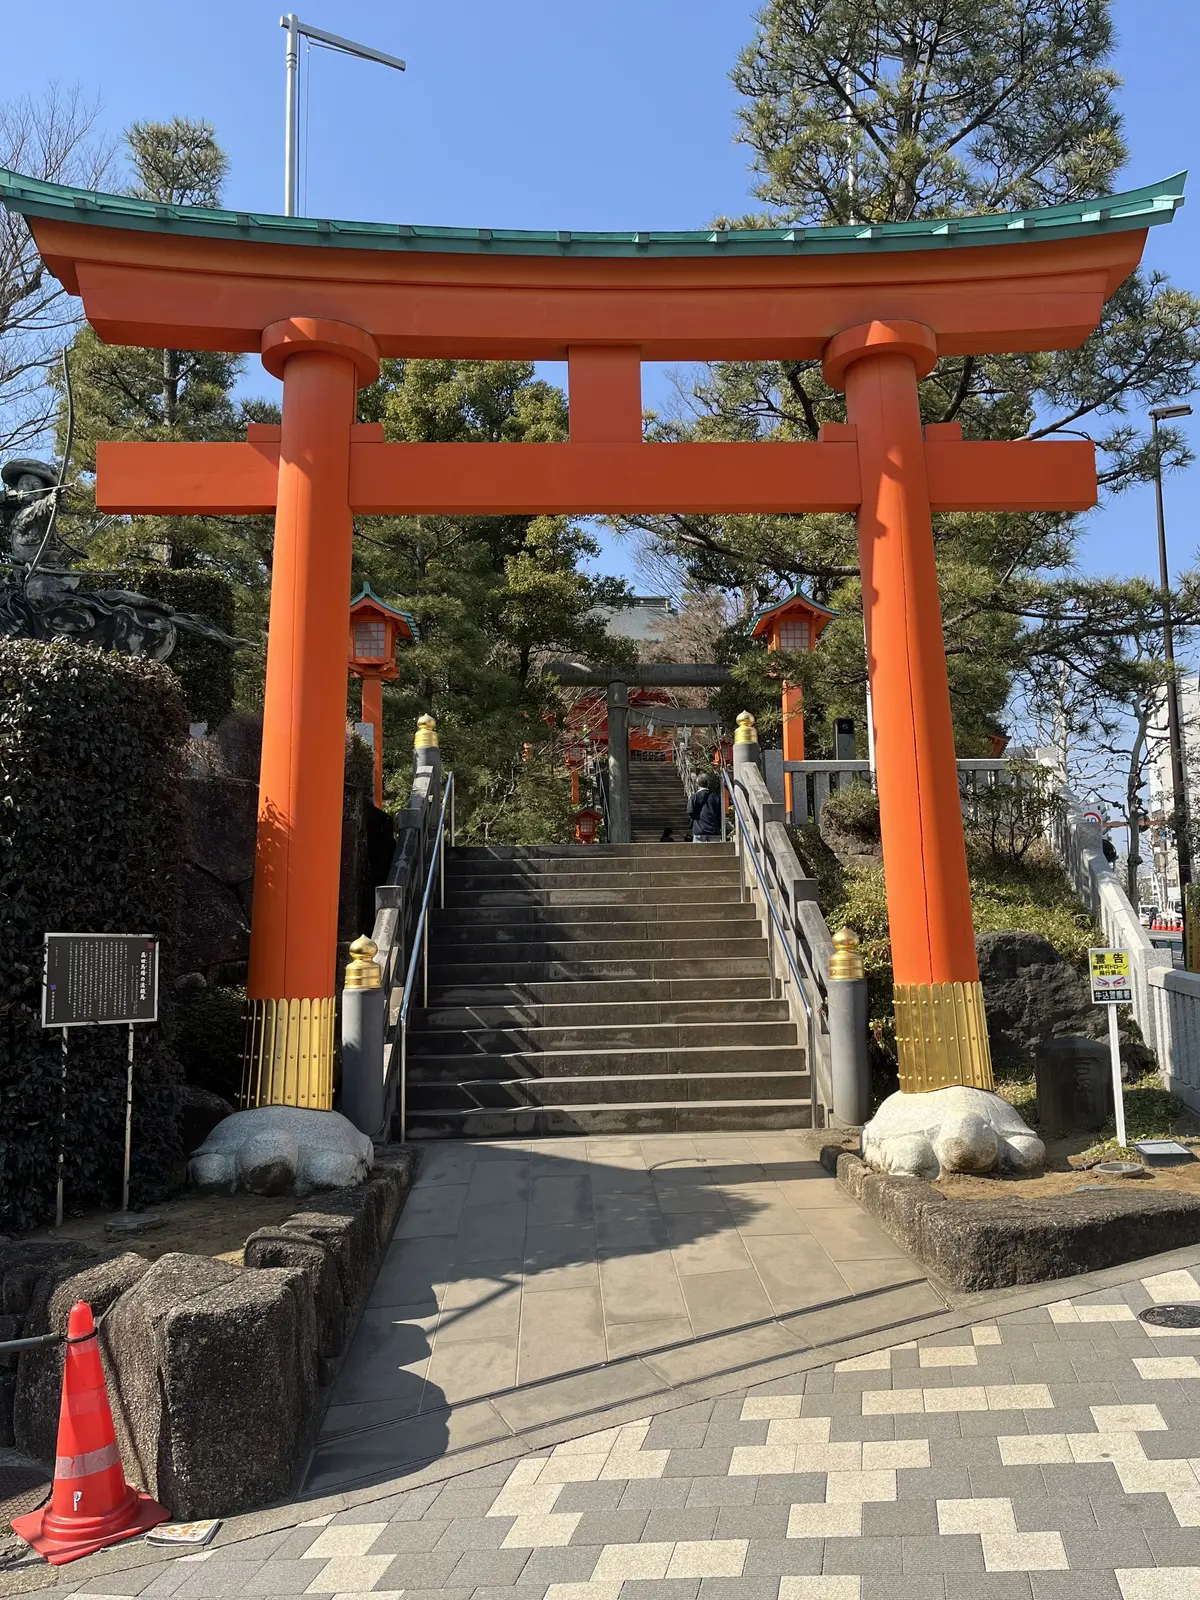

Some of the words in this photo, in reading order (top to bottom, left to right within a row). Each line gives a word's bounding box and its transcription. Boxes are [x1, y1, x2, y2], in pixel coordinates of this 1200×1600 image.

[1095, 953, 1124, 964] 警告
[1095, 991, 1130, 1000] 牛込警察署
